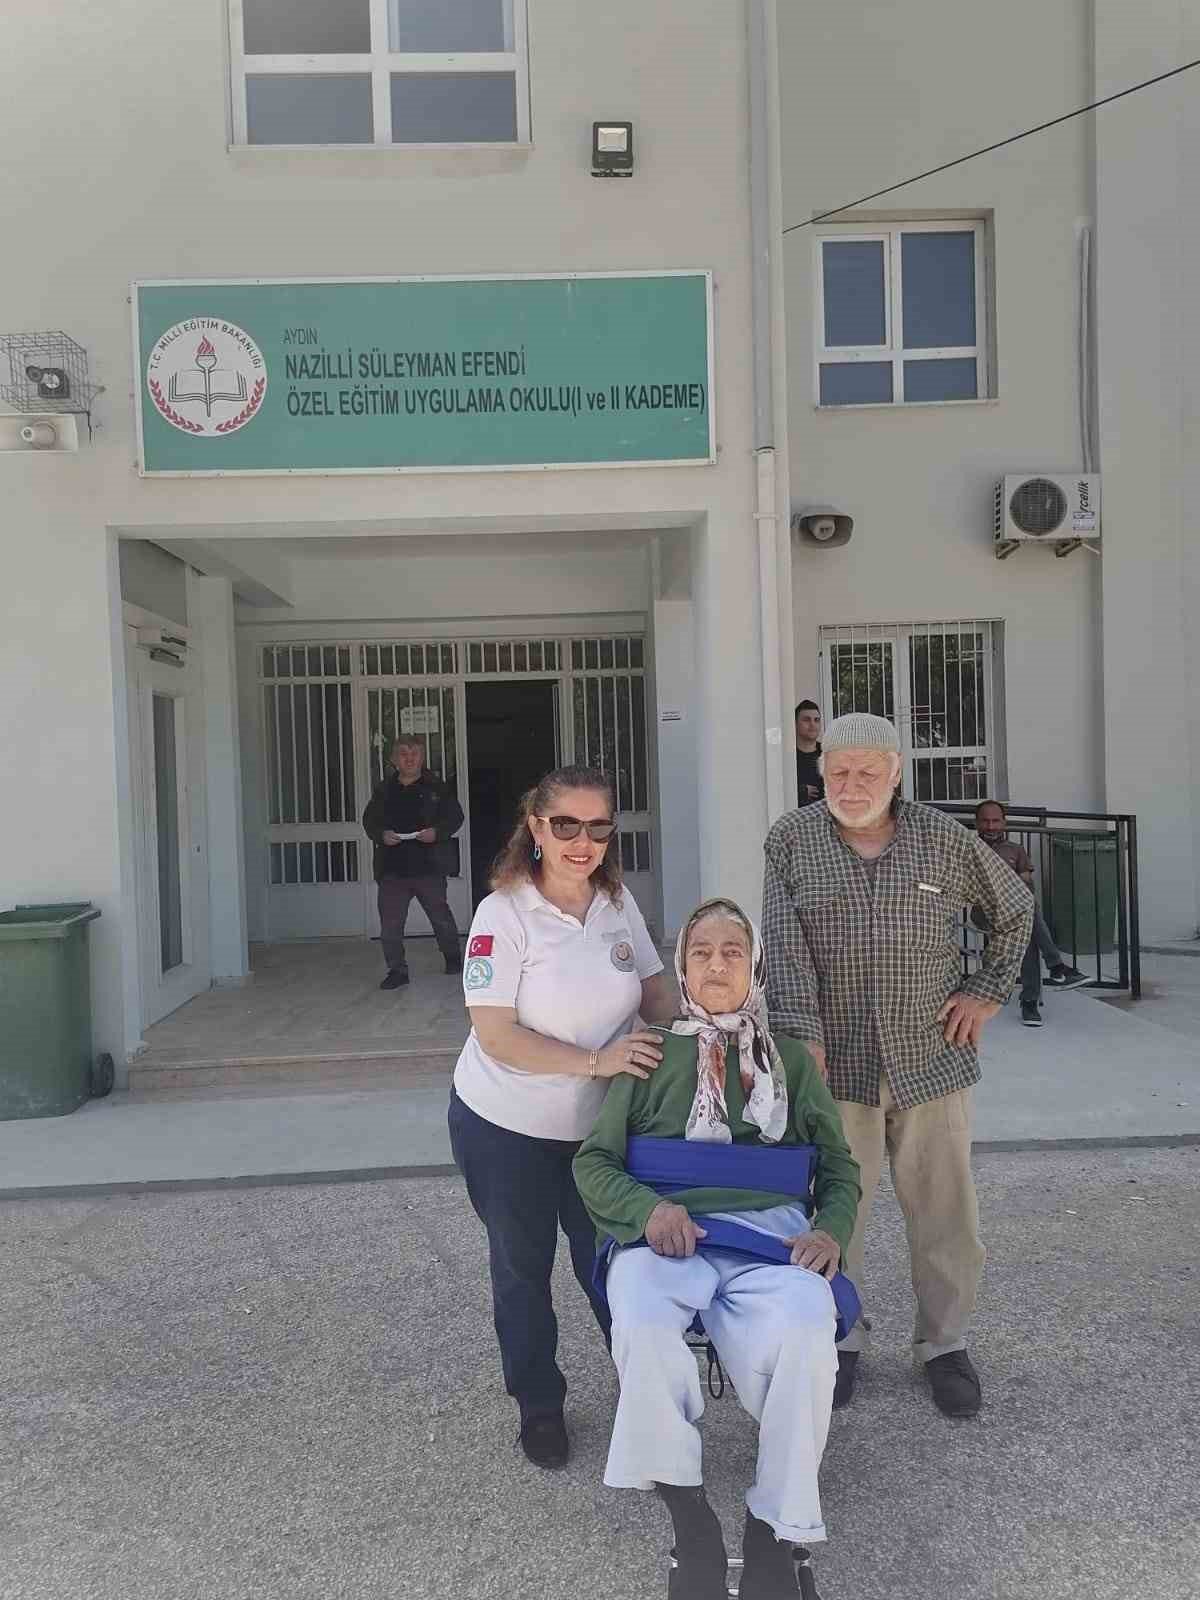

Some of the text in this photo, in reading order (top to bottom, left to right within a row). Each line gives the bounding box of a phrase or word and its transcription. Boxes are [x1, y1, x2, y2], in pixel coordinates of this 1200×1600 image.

[183, 319, 219, 332] EĞİTİM
[283, 327, 318, 345] AYDIN
[285, 344, 526, 379] NAZİLLİ SÜLEYMAN EFENDİ
[287, 385, 335, 416] ÖZEL
[339, 383, 399, 415] EĞİTİM
[404, 387, 506, 414] UYGULAMA
[586, 392, 606, 411] ve
[625, 383, 705, 415] KADEME)
